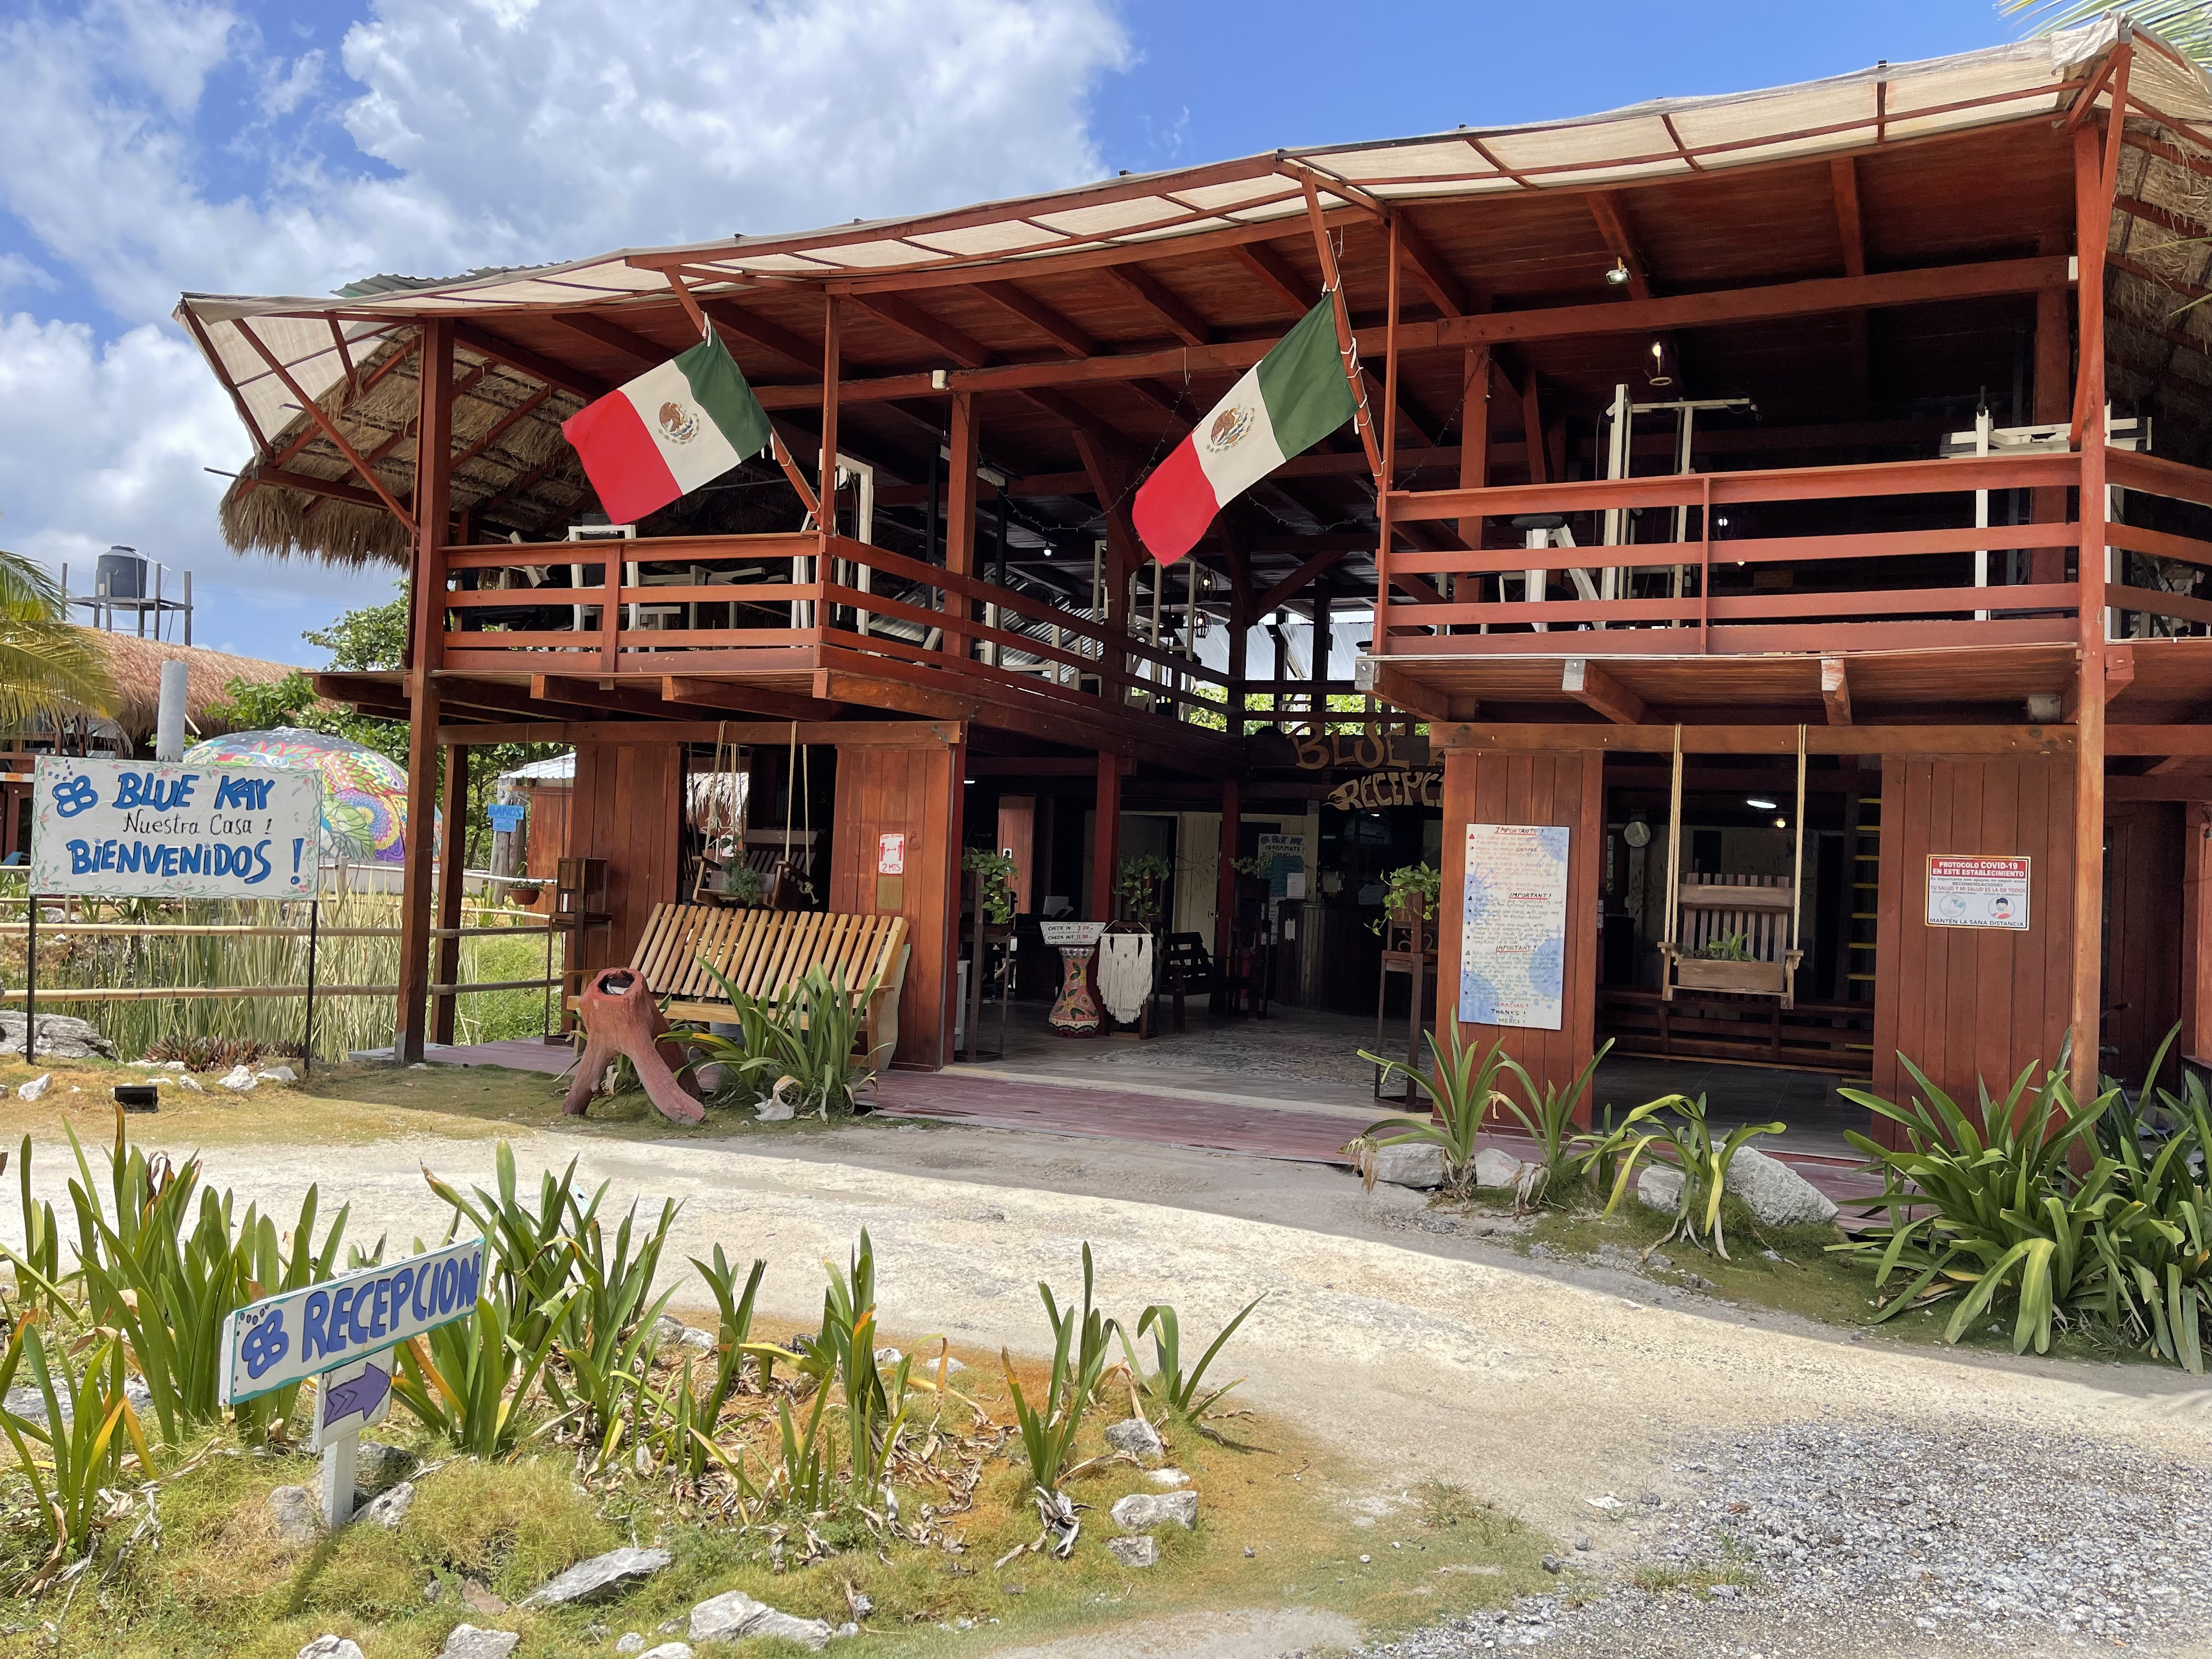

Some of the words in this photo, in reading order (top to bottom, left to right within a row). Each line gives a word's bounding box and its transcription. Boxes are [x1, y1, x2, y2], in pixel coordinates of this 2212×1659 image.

[1286, 720, 1410, 770] BLUE
[112, 772, 200, 812] BLUE
[214, 775, 275, 810] KAY
[123, 809, 201, 835] Nuestra
[210, 812, 252, 836] Casa
[882, 863, 888, 872] 2
[888, 864, 901, 872] MTS
[1962, 869, 2024, 877] ESTABLECIMIENTO
[1980, 861, 2018, 870] COVID-19
[302, 1251, 482, 1363] RECEPCION
